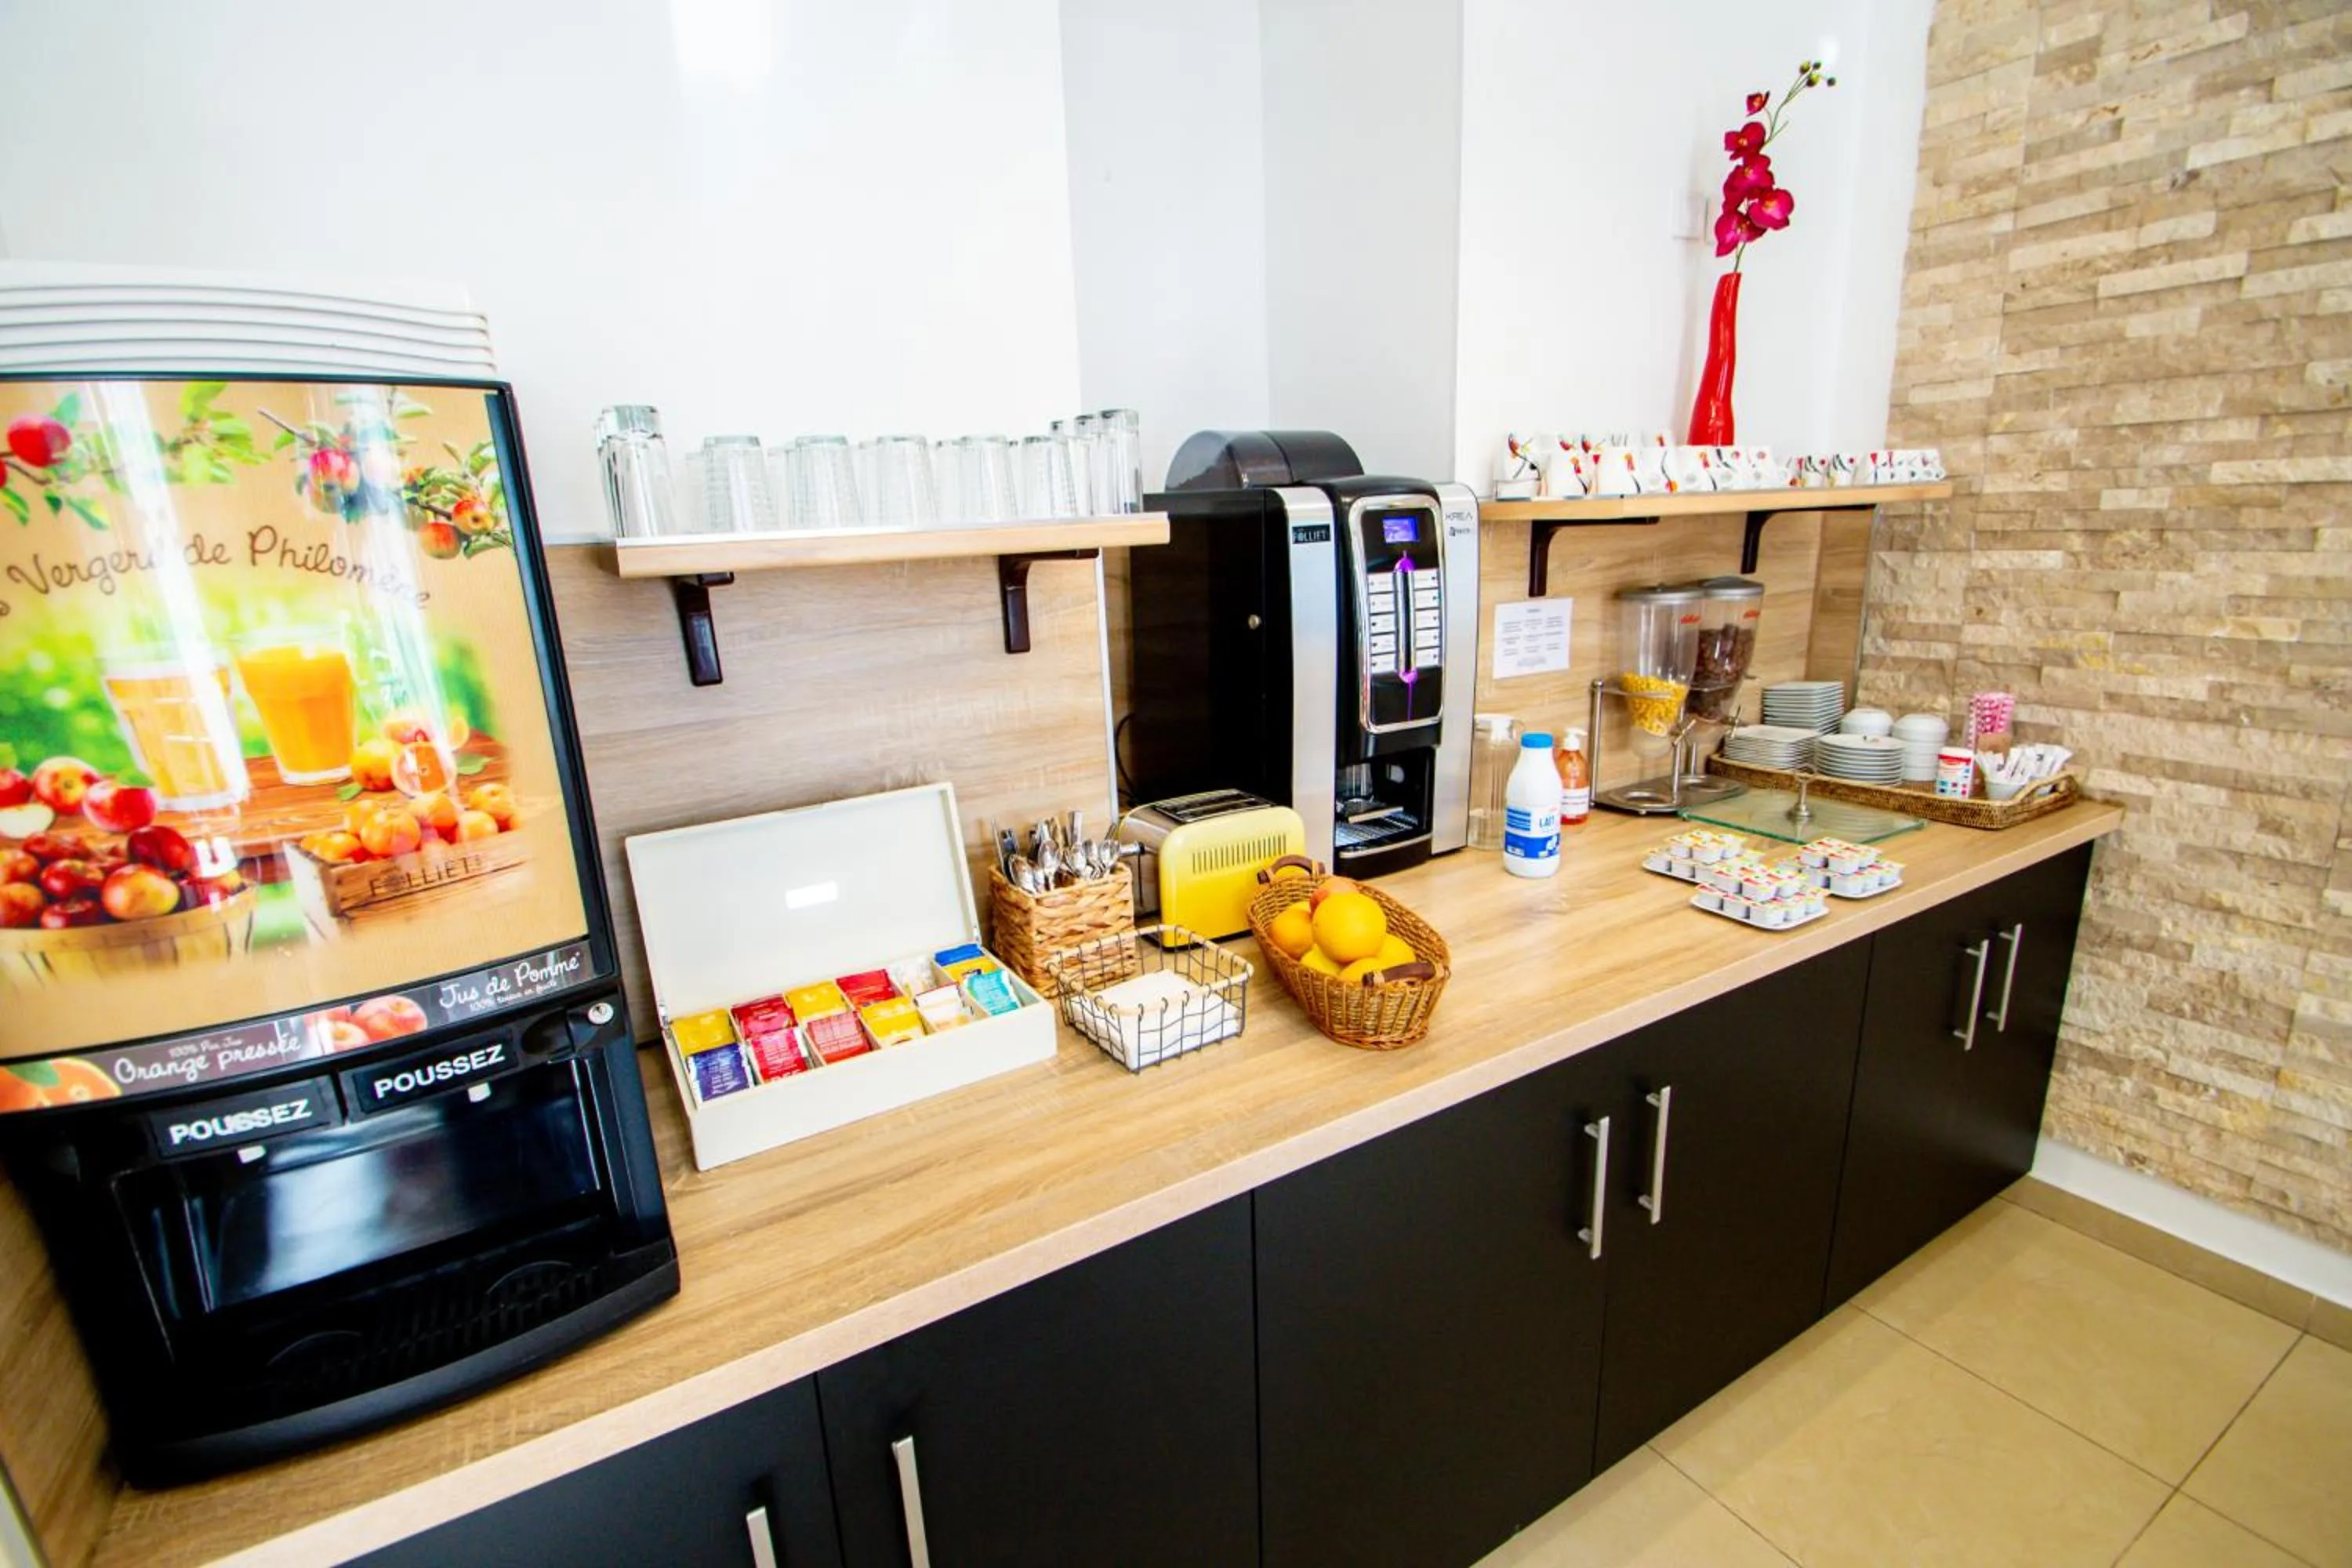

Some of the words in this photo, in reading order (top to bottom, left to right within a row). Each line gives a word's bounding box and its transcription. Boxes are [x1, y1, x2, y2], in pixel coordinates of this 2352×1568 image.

[183, 533, 232, 565] de
[439, 982, 479, 1008] Jus
[485, 975, 511, 996] de
[114, 1054, 210, 1083] Orange
[218, 1031, 301, 1071] pressée
[374, 1044, 505, 1099] POUSSEZ
[169, 1098, 313, 1145] POUSSEZ
